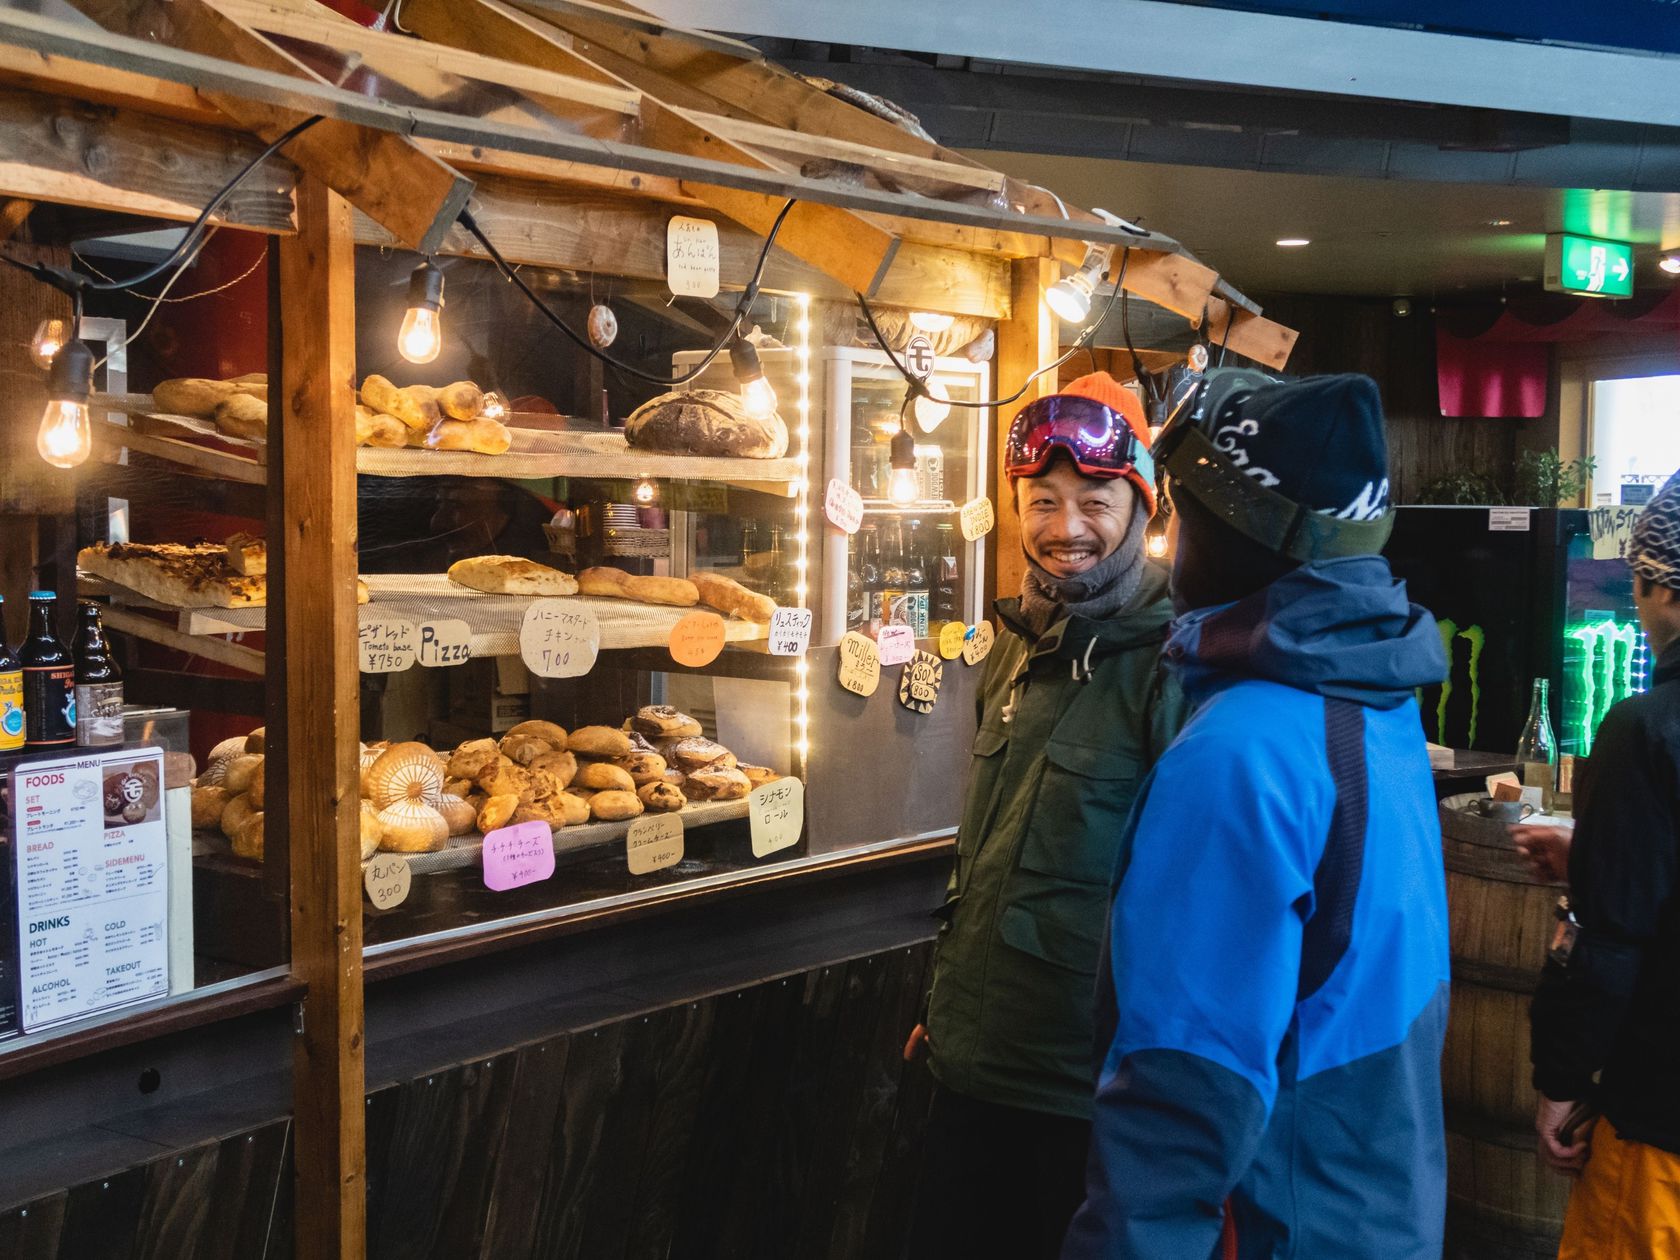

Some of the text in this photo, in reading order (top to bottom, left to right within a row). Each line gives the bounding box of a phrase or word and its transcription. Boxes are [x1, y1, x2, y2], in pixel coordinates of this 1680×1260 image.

[543, 628, 573, 643] チキン
[392, 642, 413, 652] base
[420, 626, 472, 662] Pizza
[777, 640, 799, 653] ¥400
[542, 649, 570, 672] 700
[847, 638, 879, 669] Miller
[368, 654, 403, 670] ¥750
[914, 664, 934, 686] SOL
[913, 685, 930, 698] 800
[77, 759, 101, 770] MENU
[26, 773, 65, 789] FOODS
[25, 795, 41, 805] SET
[759, 786, 792, 806] シナモン
[764, 809, 788, 825] ロール
[103, 830, 126, 840] PIZZA
[26, 841, 54, 854] BREAD
[105, 854, 145, 868] SIDEMENU
[371, 862, 406, 882] 丸パン
[377, 883, 402, 903] 300
[29, 916, 70, 934] DRINKS
[104, 920, 126, 932] COLD
[29, 937, 47, 949] HOT
[105, 960, 142, 976] TAKEOUT
[32, 978, 71, 995] ALCOHOL
